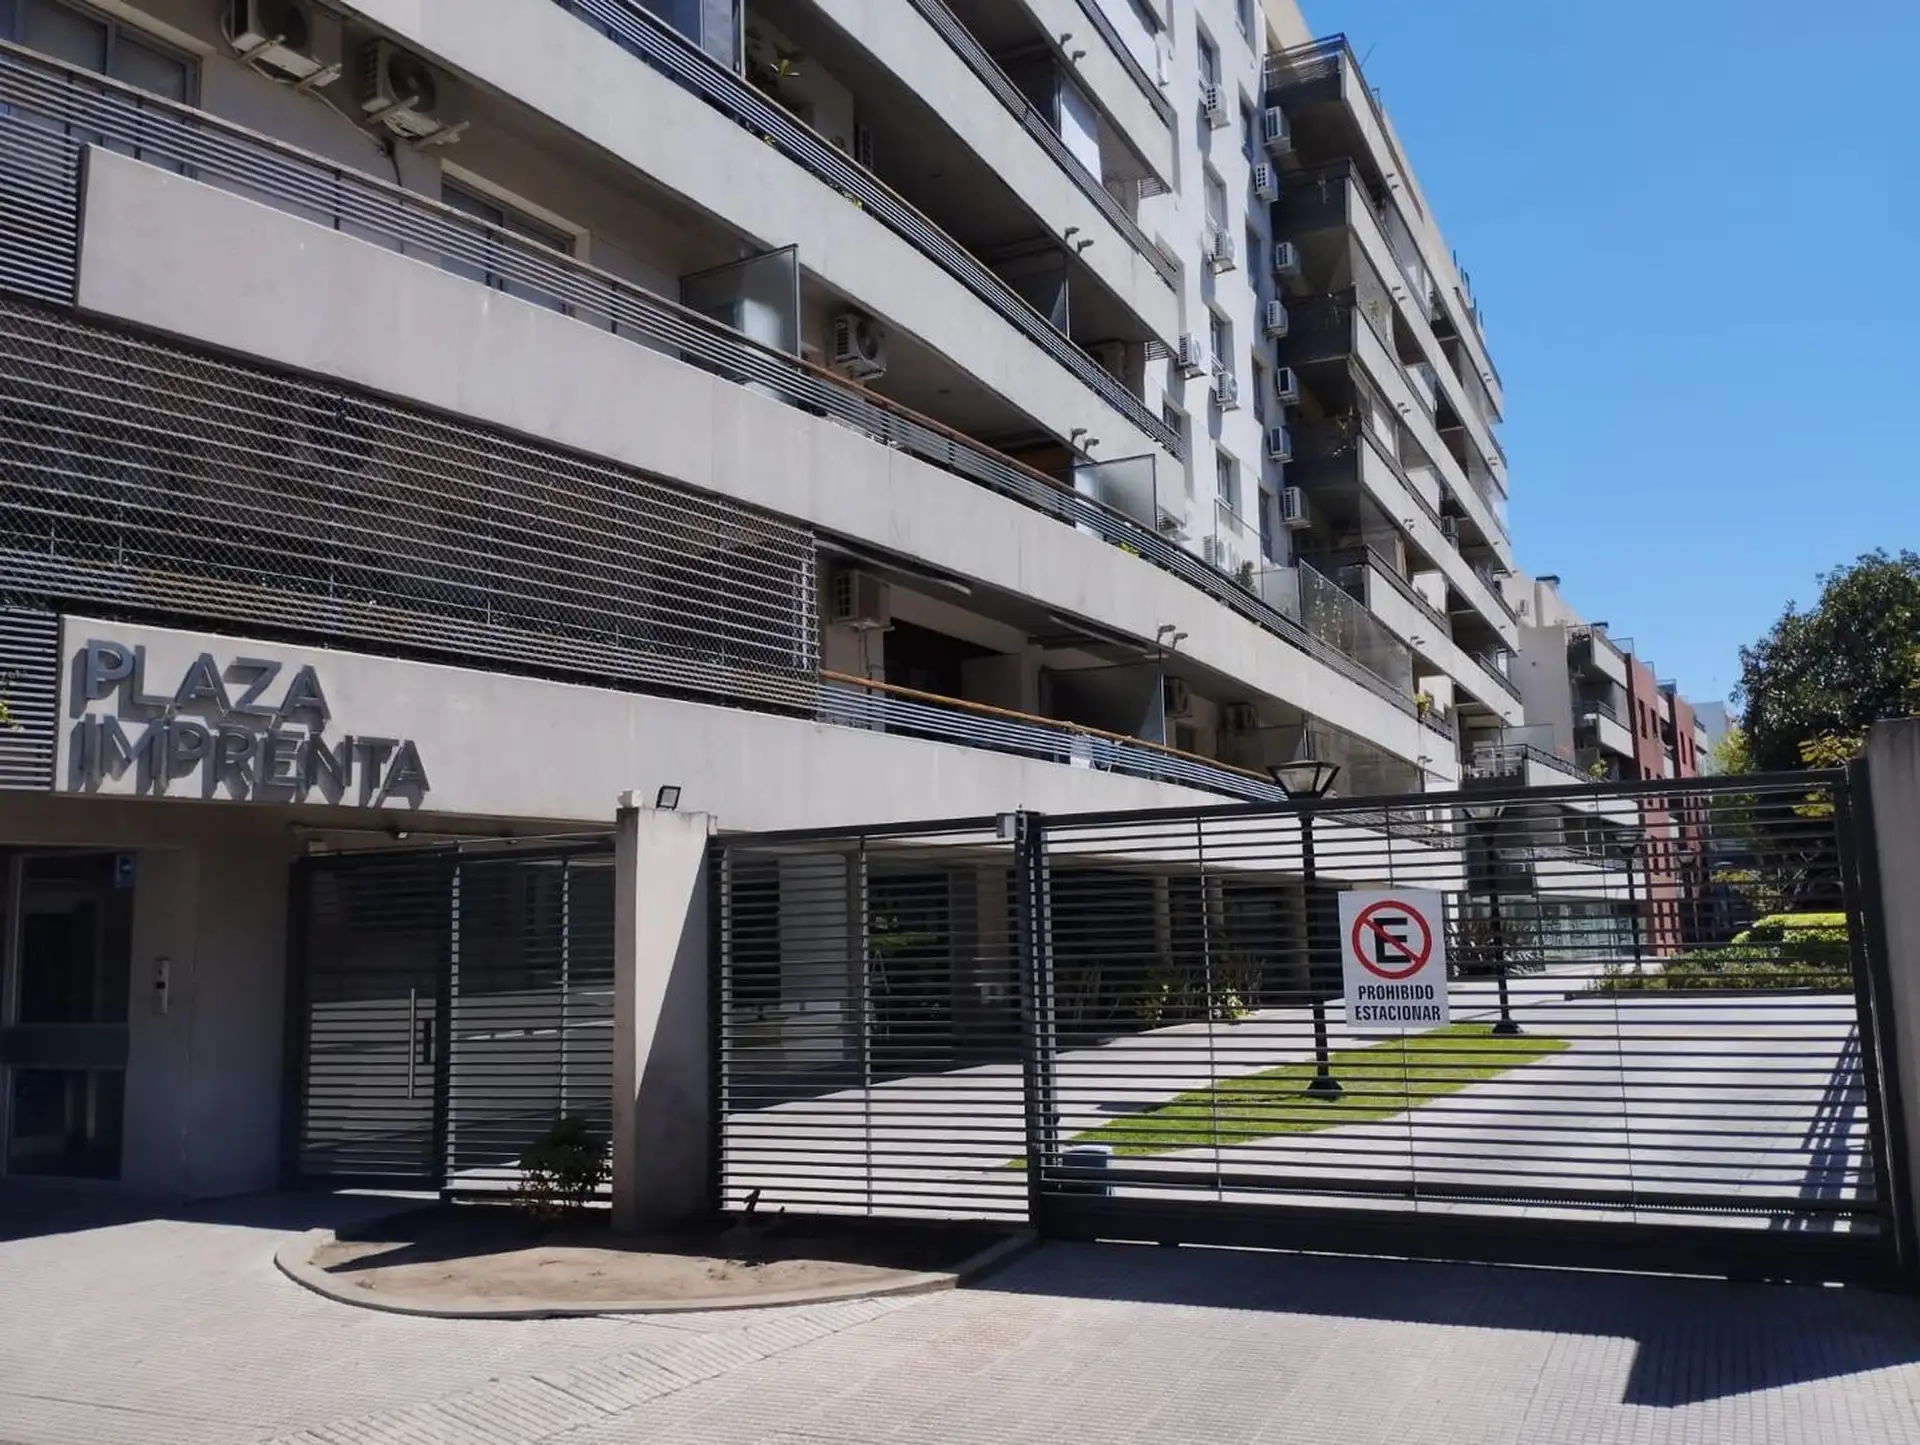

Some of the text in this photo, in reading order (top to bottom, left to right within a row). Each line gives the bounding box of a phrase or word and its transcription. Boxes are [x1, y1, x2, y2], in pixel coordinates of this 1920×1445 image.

[84, 639, 331, 720] PLAZA
[78, 713, 430, 796] IMPRENTA
[1373, 917, 1412, 963] E
[1355, 1005, 1441, 1021] ESTACIONAR
[1358, 985, 1434, 1000] PROHIBIDO
